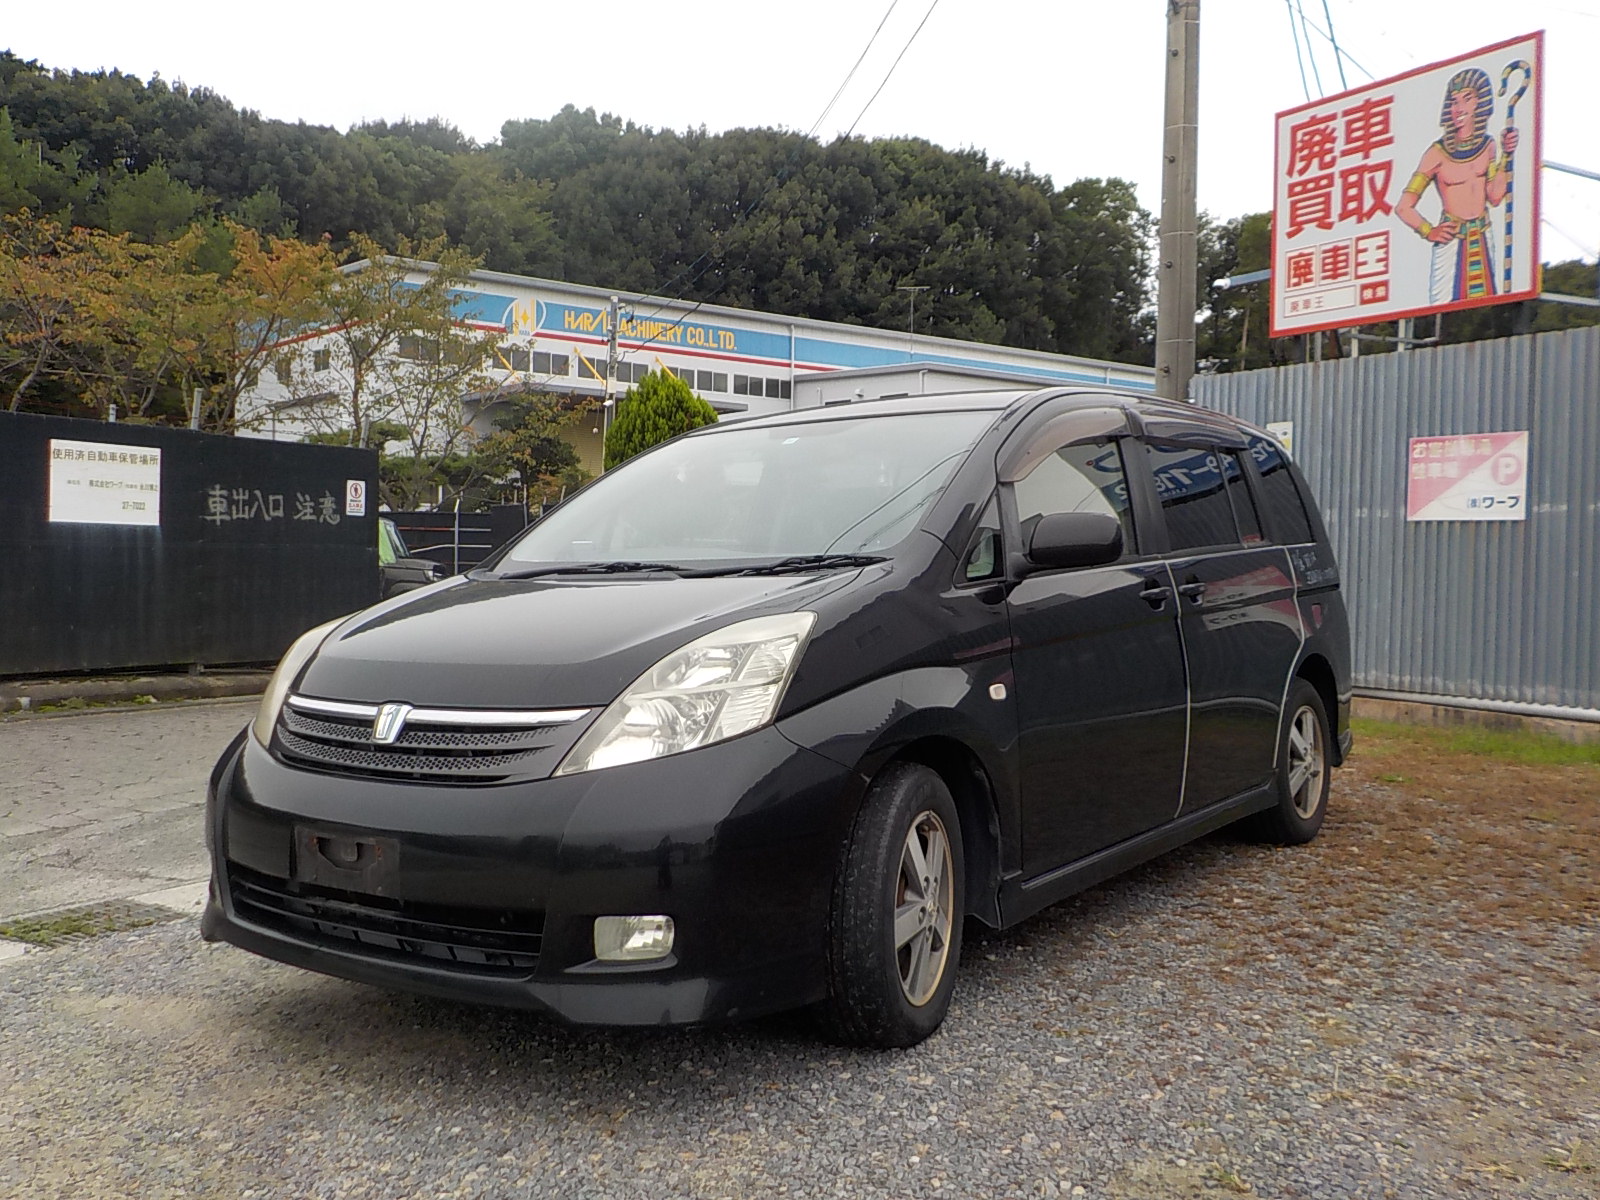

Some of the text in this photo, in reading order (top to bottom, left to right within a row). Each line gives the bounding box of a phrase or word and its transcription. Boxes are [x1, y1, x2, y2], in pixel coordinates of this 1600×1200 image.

[1286, 96, 1394, 178] 廃車
[1286, 159, 1394, 239] 買取
[1287, 231, 1389, 289] 廃車王
[564, 308, 607, 333] HARA
[608, 314, 685, 344] ACHINERY
[52, 447, 160, 466] 使用済自動車保管場所
[202, 482, 341, 526] 車出入口 注意
